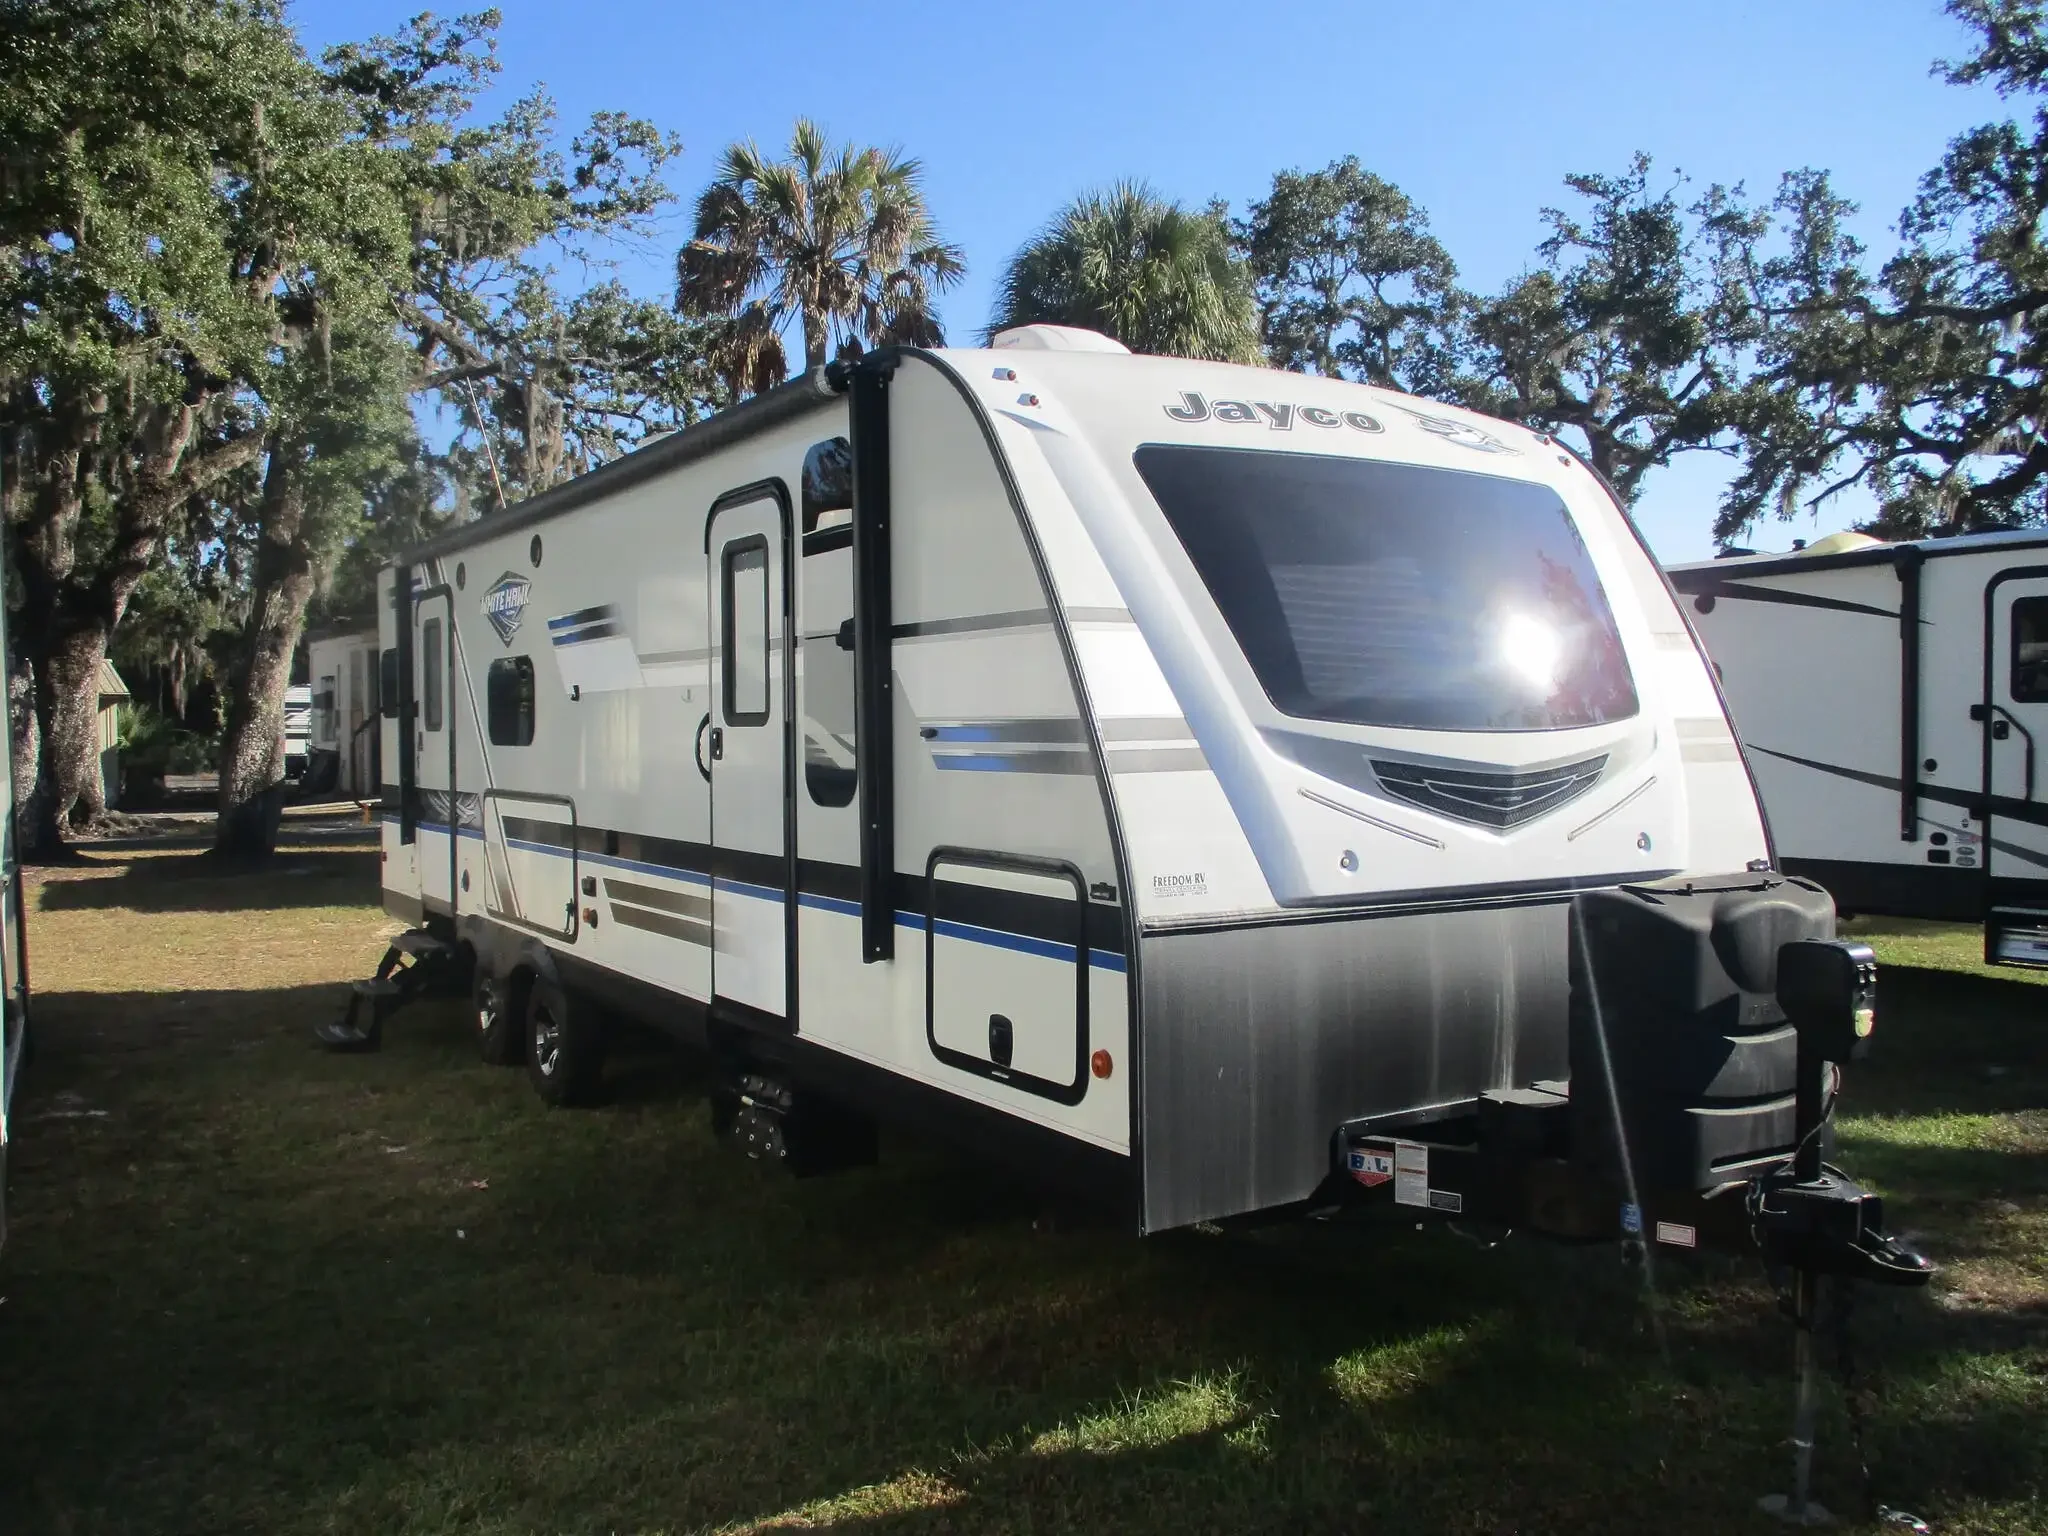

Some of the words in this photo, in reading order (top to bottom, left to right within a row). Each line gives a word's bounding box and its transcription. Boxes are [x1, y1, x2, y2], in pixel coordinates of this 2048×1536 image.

[1163, 390, 1386, 434] Jayco
[1153, 874, 1192, 888] FREEDOM
[1194, 872, 1206, 884] RV
